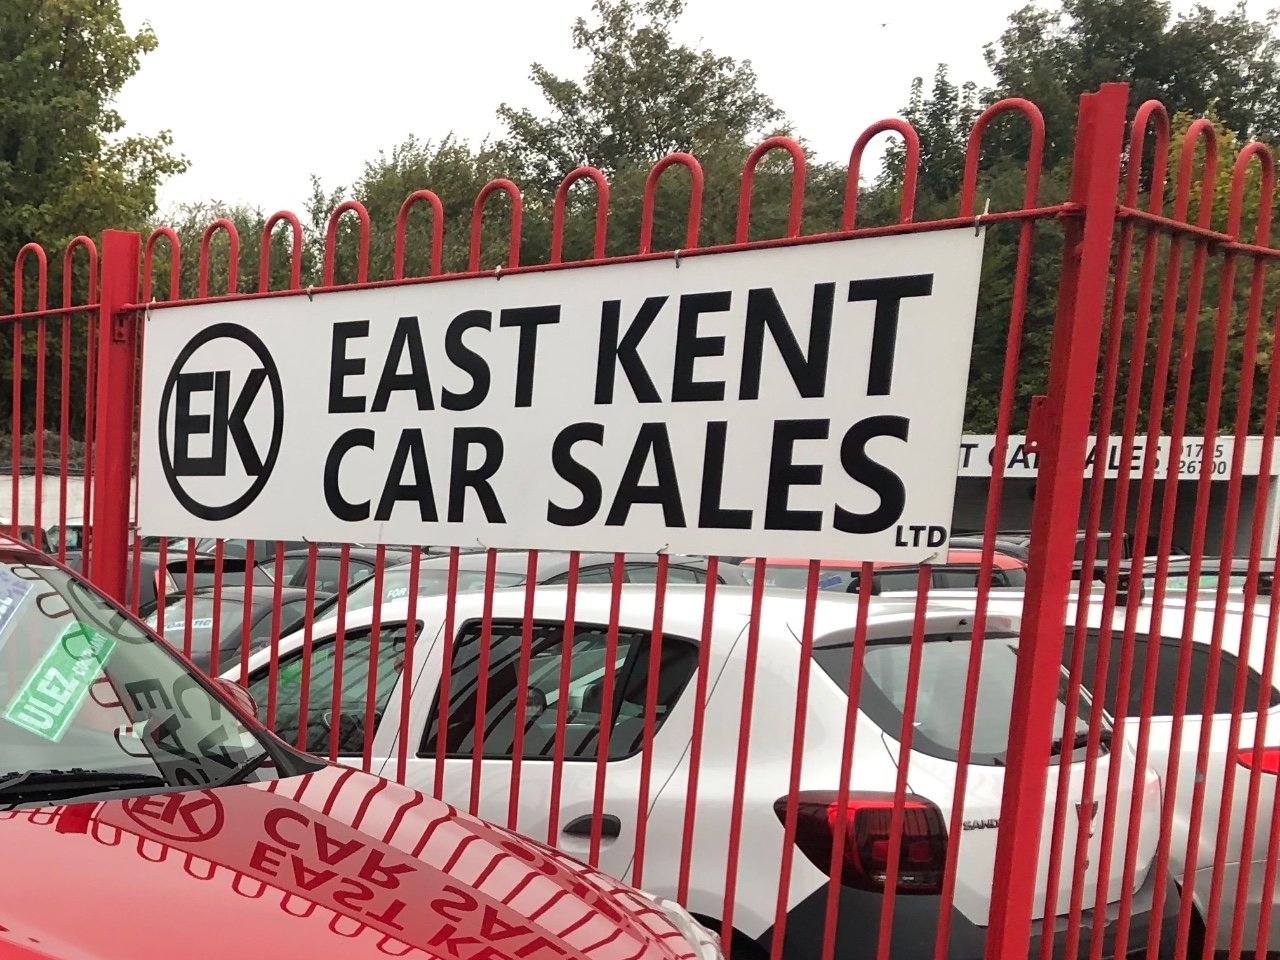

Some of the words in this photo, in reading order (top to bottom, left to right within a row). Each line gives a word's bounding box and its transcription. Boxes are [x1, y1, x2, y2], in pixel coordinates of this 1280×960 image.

[327, 304, 561, 414] EAST
[594, 273, 934, 405] KENT
[323, 426, 507, 524] CAR
[546, 414, 910, 535] SALES
[894, 525, 947, 548] LTD
[386, 587, 407, 599] FOR
[18, 666, 77, 731] ULEZ
[963, 818, 999, 831] SAND
